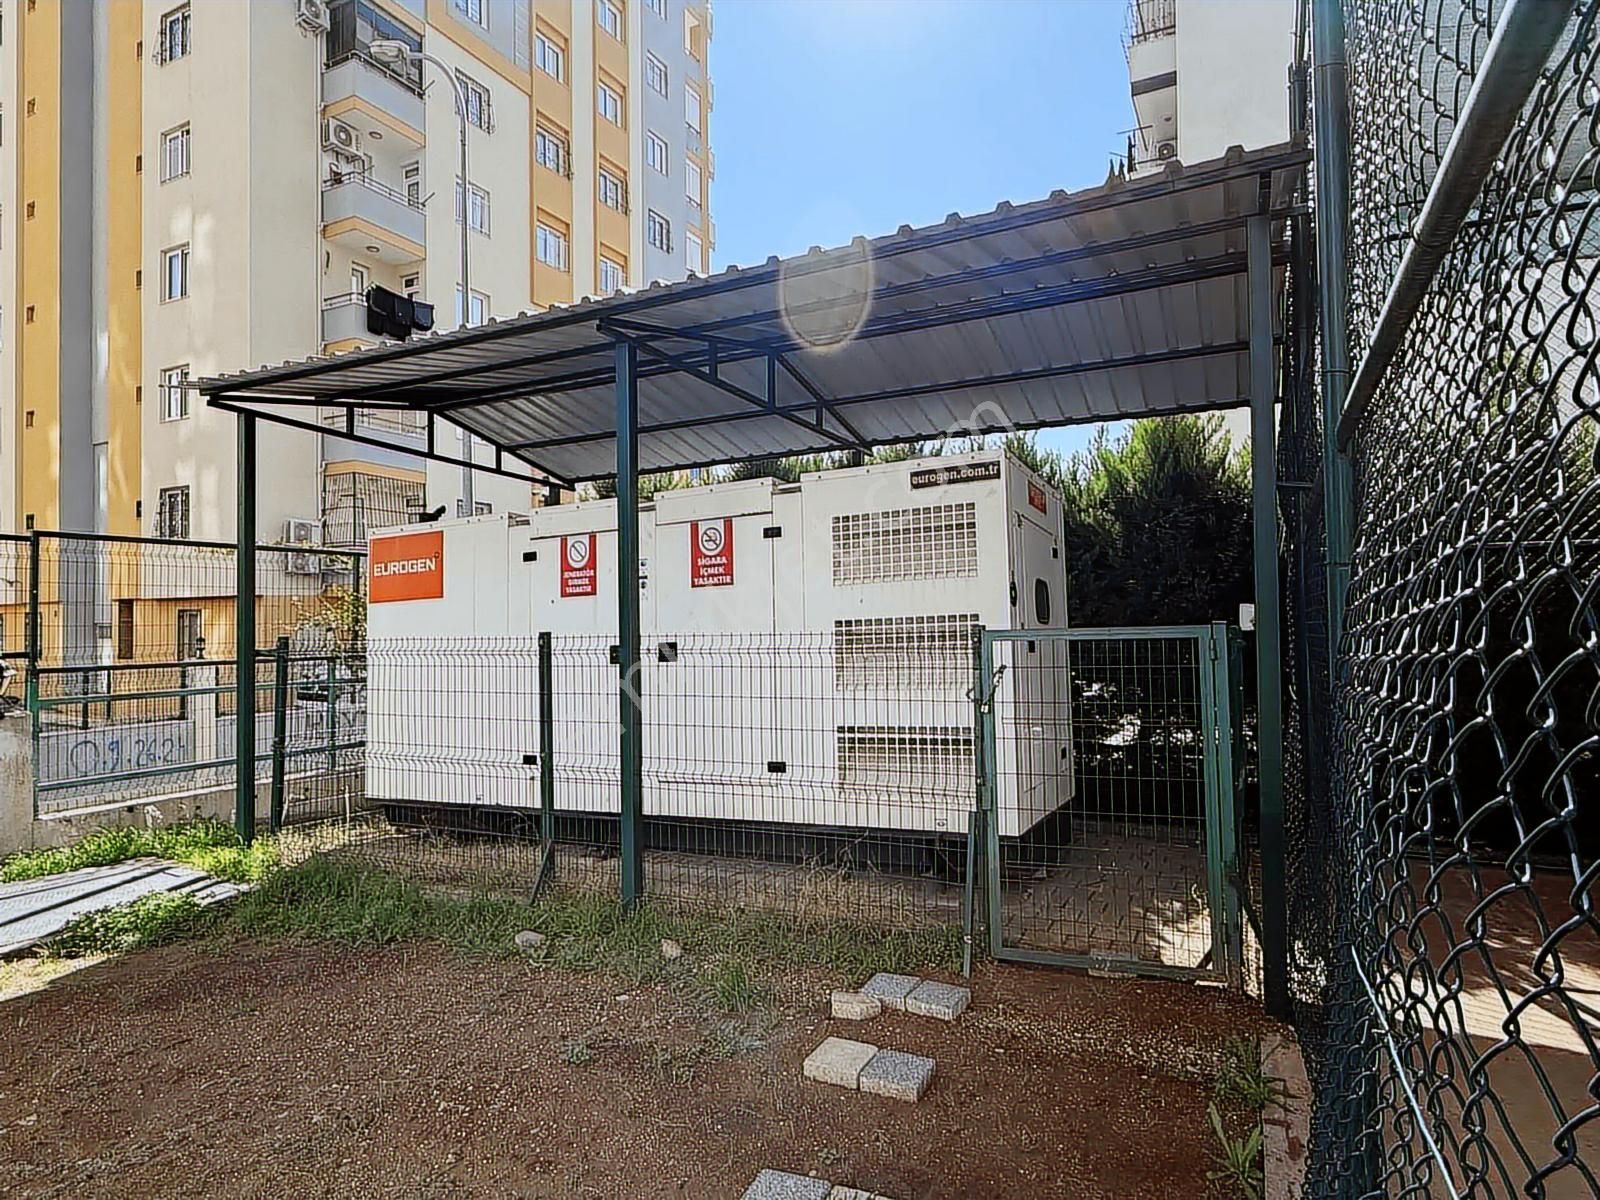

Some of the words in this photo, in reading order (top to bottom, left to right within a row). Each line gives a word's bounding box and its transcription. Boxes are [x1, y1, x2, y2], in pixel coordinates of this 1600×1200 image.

[911, 464, 998, 485] eurogen.com.tr
[373, 558, 436, 577] EUROGEN
[694, 575, 732, 586] YASAKTIR
